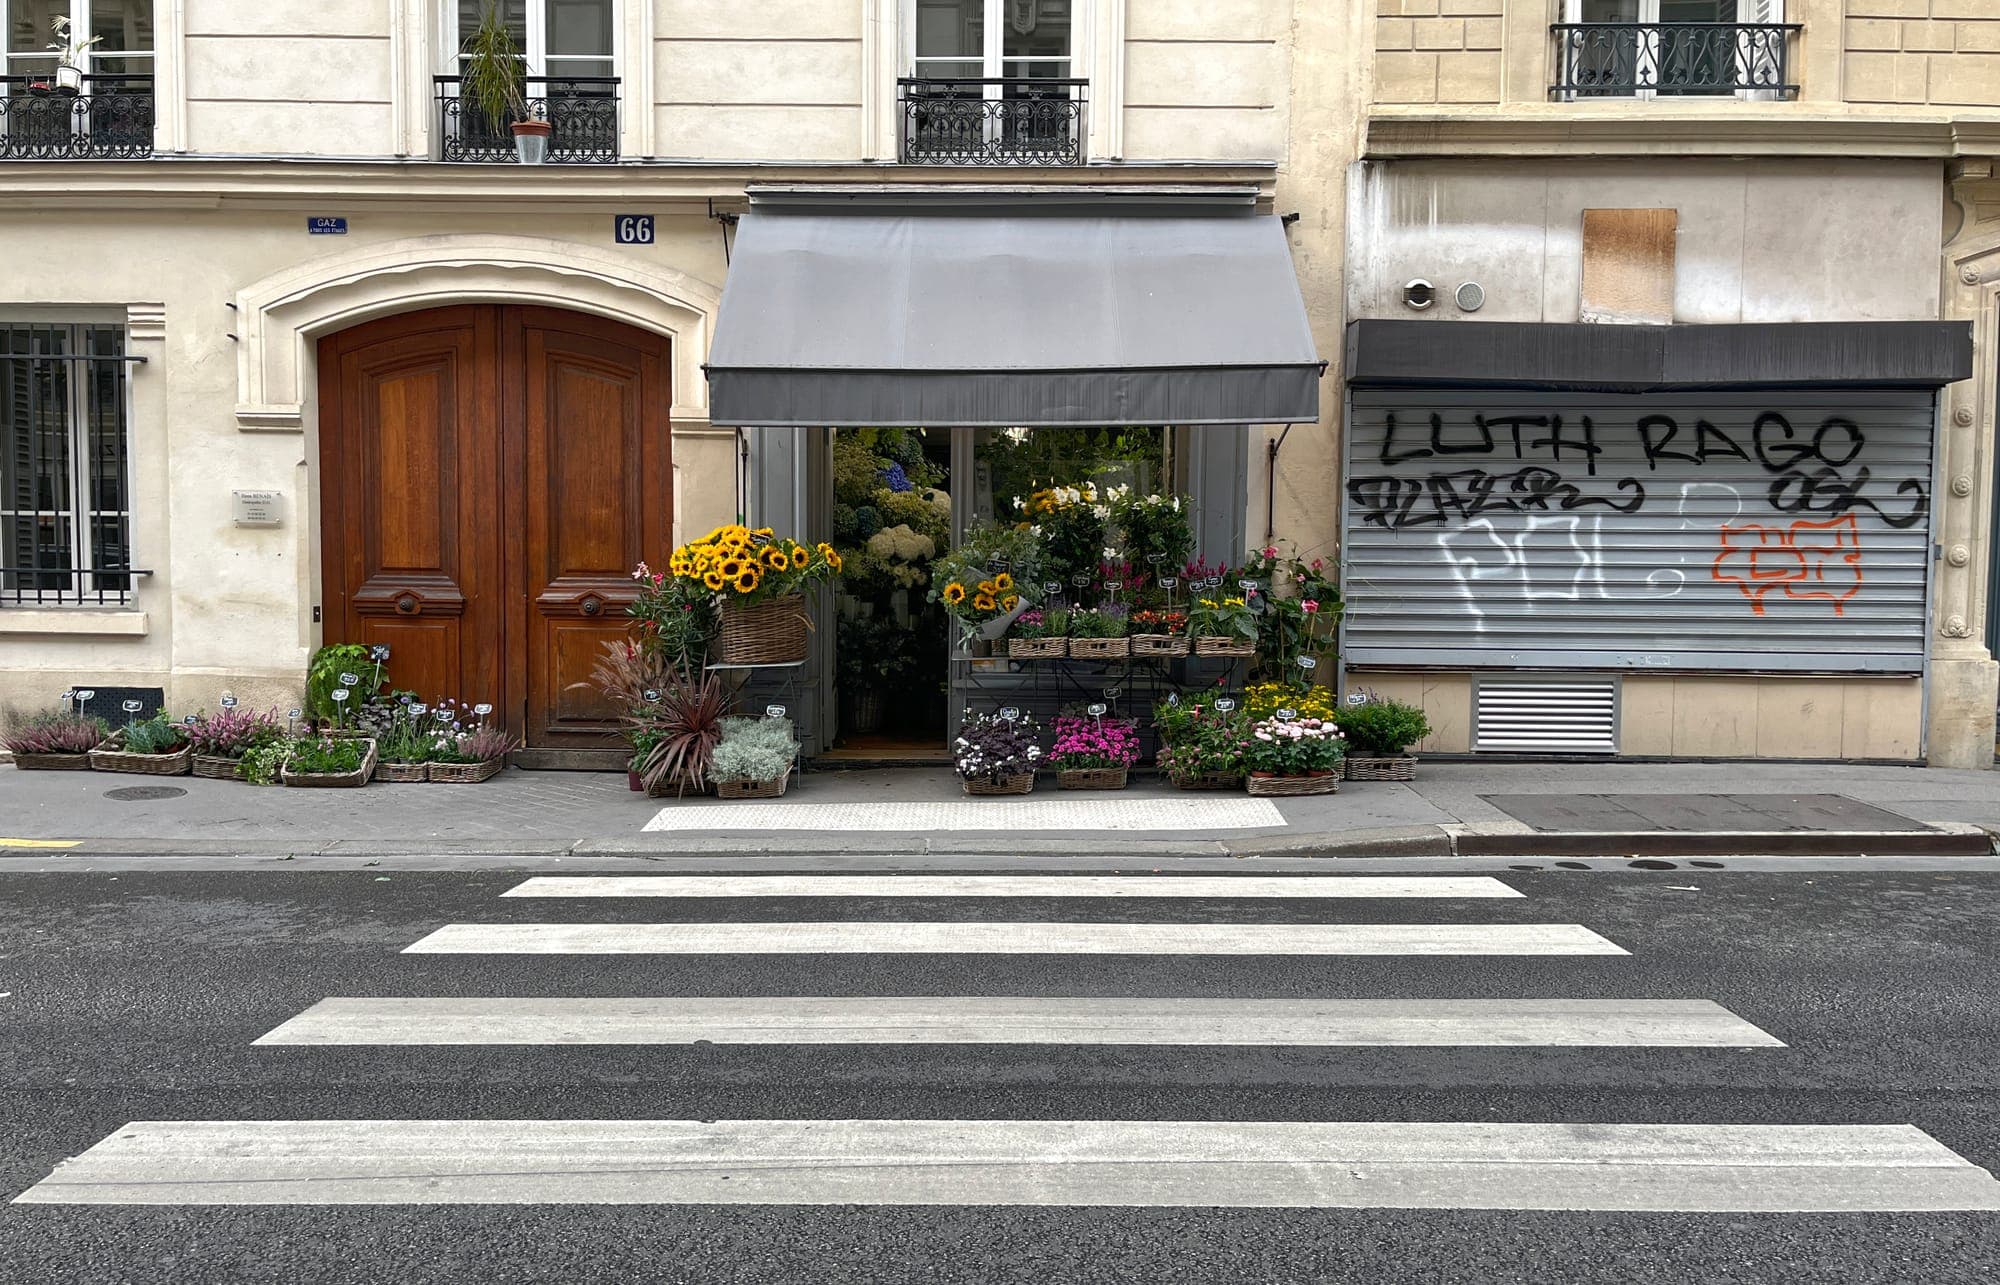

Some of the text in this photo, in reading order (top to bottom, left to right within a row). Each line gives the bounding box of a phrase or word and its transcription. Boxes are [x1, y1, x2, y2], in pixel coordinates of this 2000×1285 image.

[317, 218, 336, 227] GAZ
[620, 217, 651, 242] 66
[1379, 412, 1865, 475] LUTH RAGO
